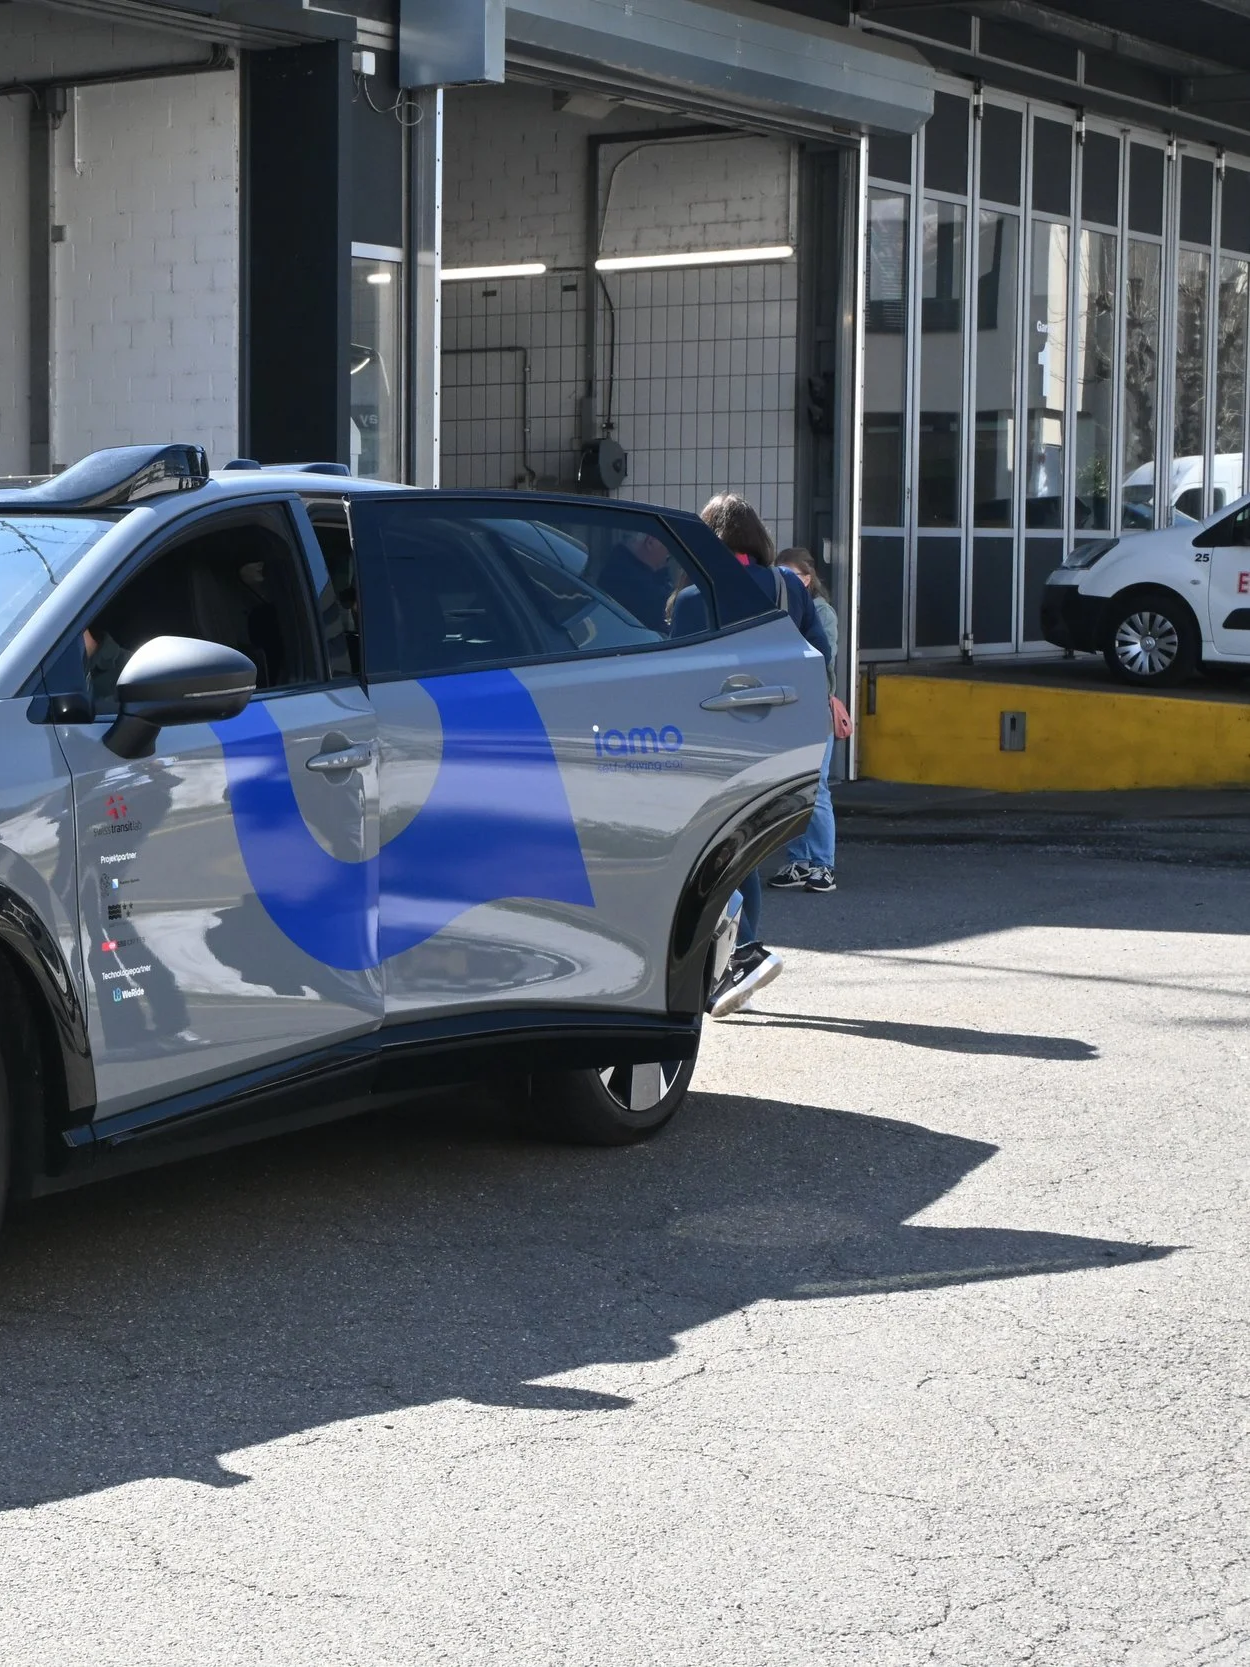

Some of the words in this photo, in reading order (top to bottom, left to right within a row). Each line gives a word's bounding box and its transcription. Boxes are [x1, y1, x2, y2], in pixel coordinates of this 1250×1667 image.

[1195, 553, 1210, 563] 25
[592, 724, 683, 758] iamo
[100, 852, 137, 864] Projektpartner
[102, 965, 151, 980] Technologiepartner
[122, 987, 145, 999] WeRide
